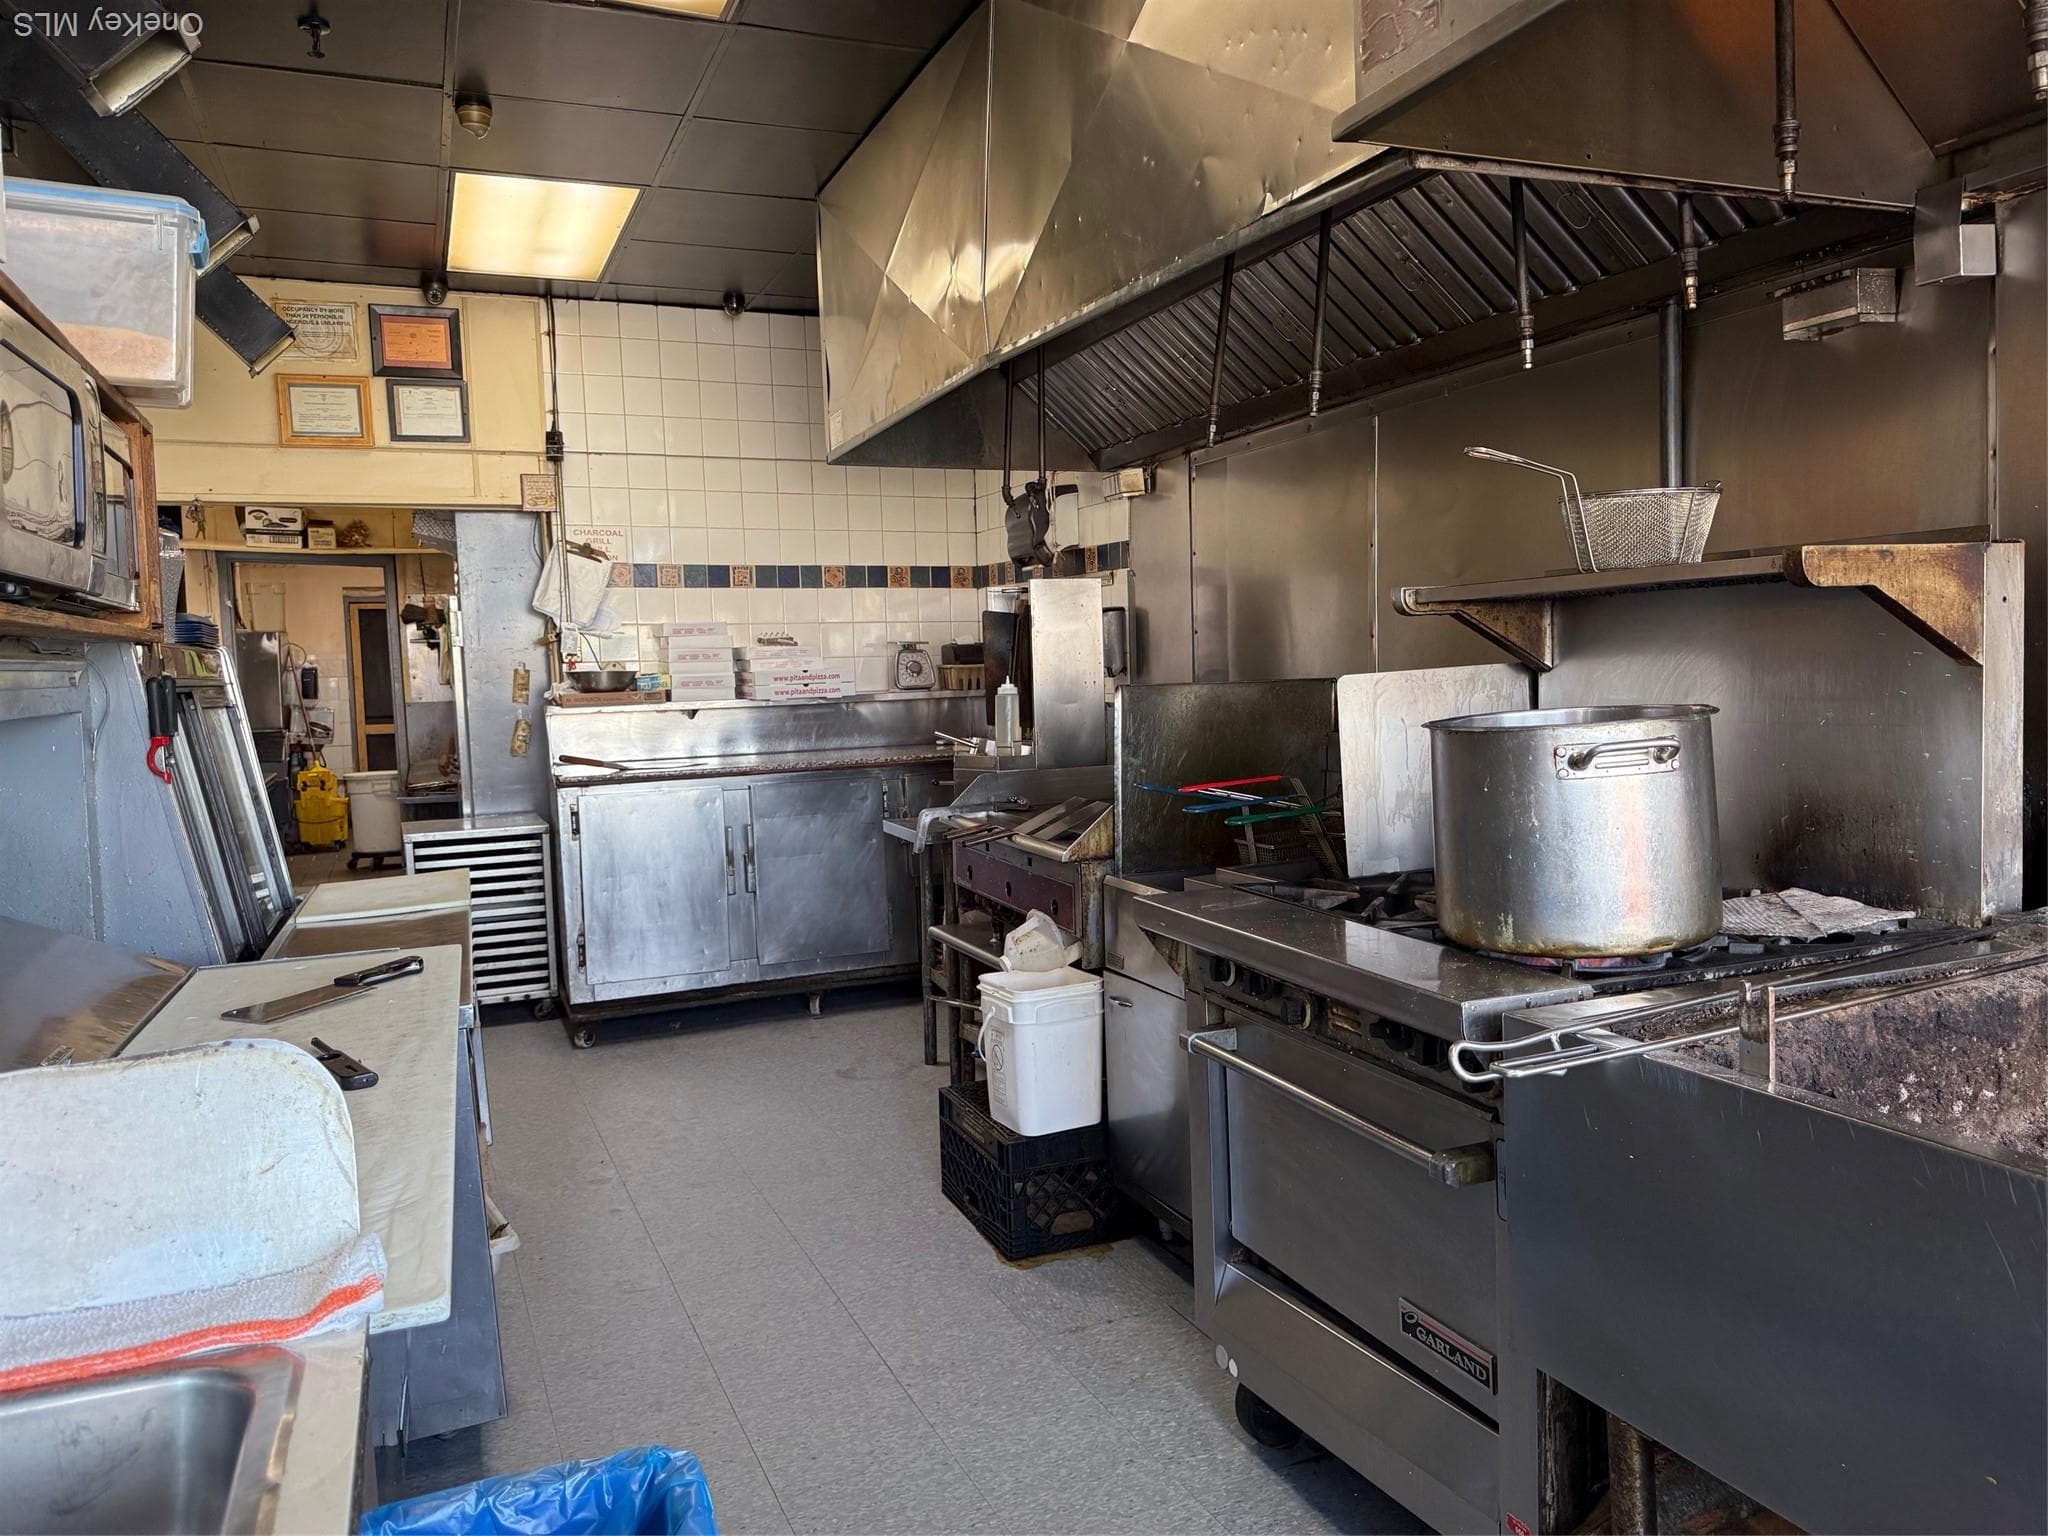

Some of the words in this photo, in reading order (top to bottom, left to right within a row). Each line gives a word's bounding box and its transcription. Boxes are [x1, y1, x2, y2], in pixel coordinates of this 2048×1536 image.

[572, 529, 624, 537] CHARCOAL
[586, 537, 613, 545] GRILL
[773, 673, 840, 682] www.pitaandpizza.com
[774, 687, 841, 696] www.pitaandpizza.com
[1416, 1326, 1487, 1381] GARLAND
